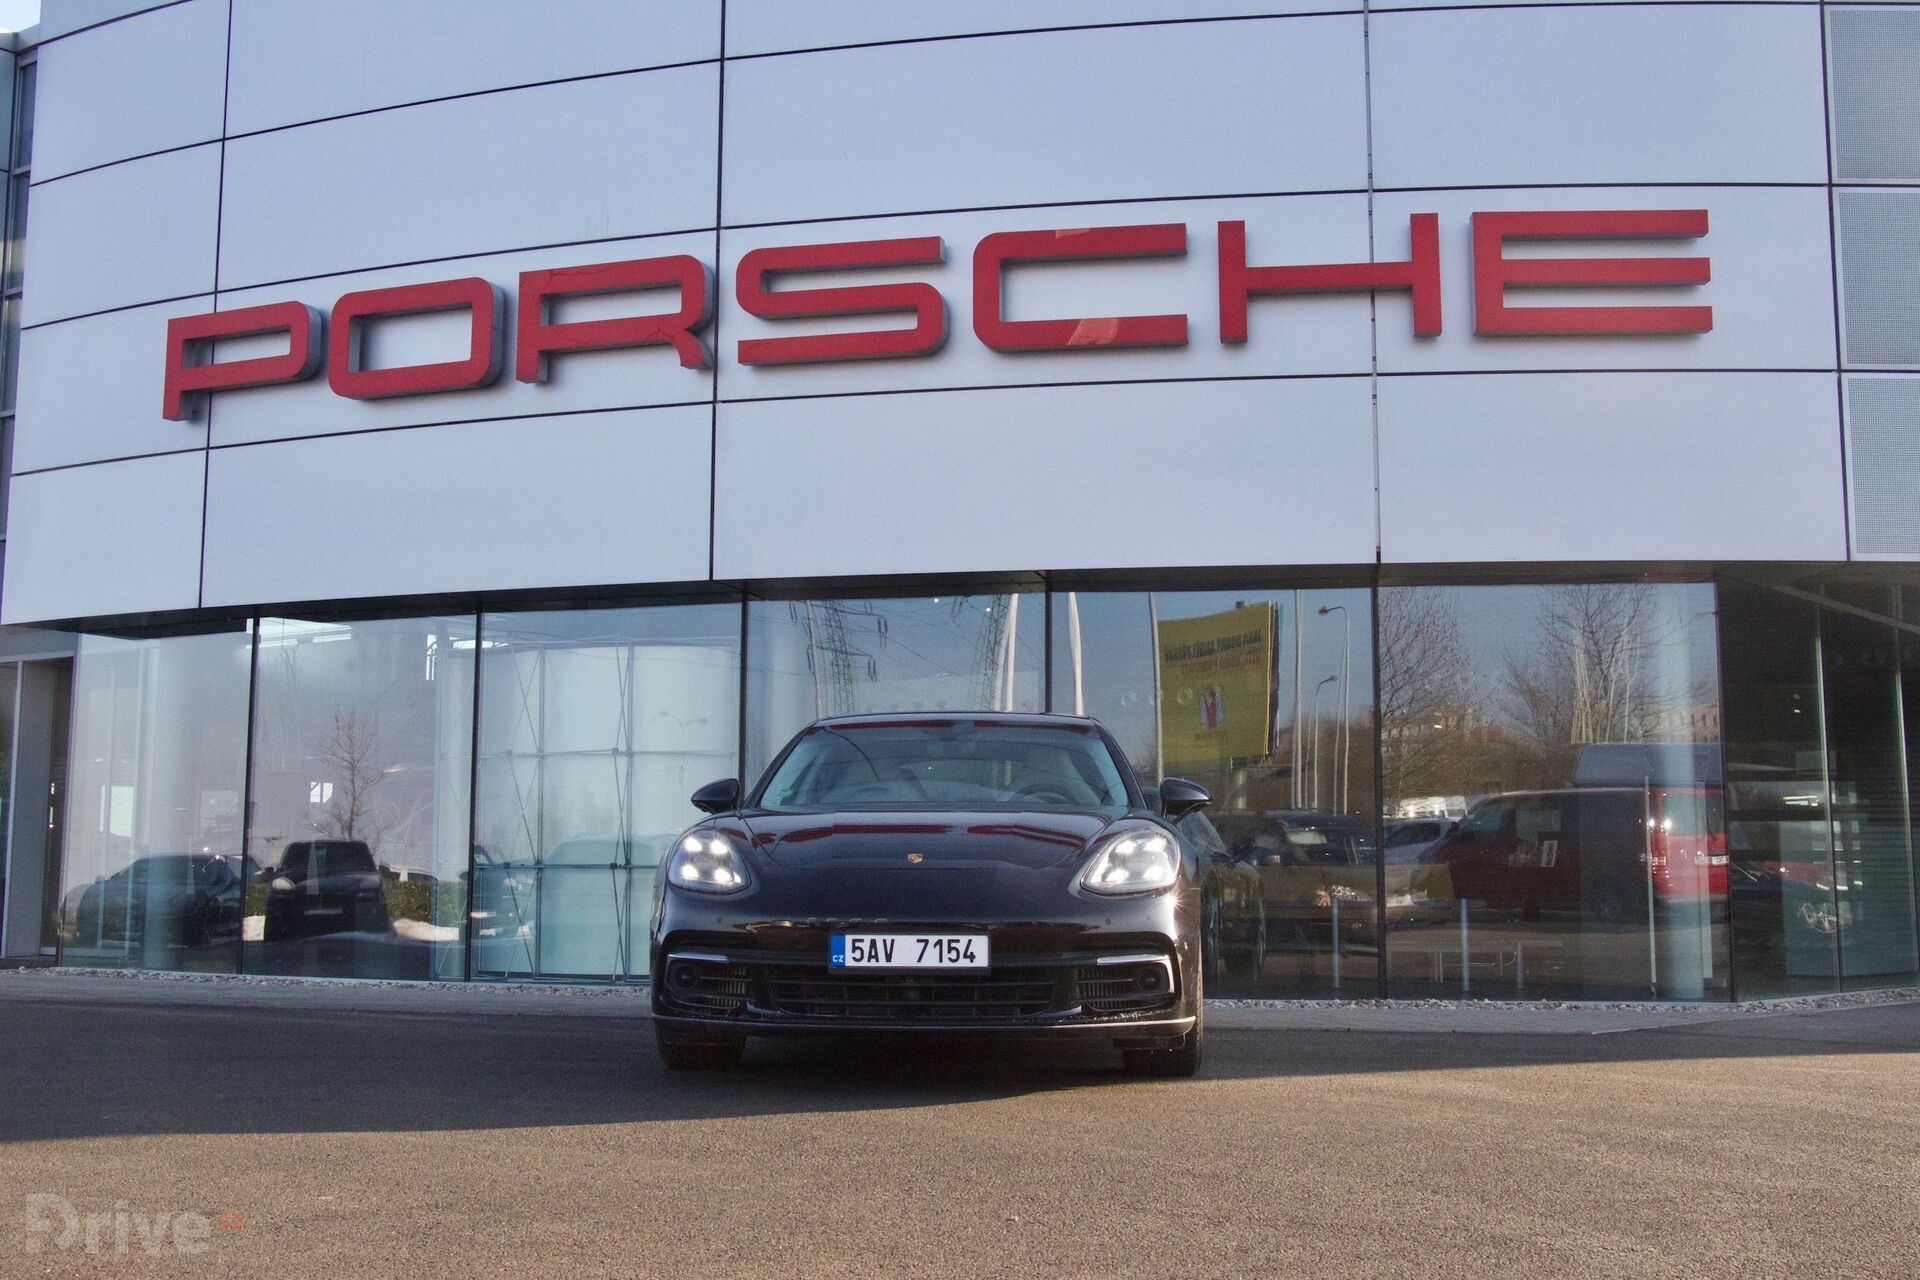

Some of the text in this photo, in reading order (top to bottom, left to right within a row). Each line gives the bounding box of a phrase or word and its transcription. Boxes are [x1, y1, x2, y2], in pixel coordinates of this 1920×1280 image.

[162, 209, 1713, 422] PORSCHE
[832, 938, 976, 963] CZ 5AV 7154
